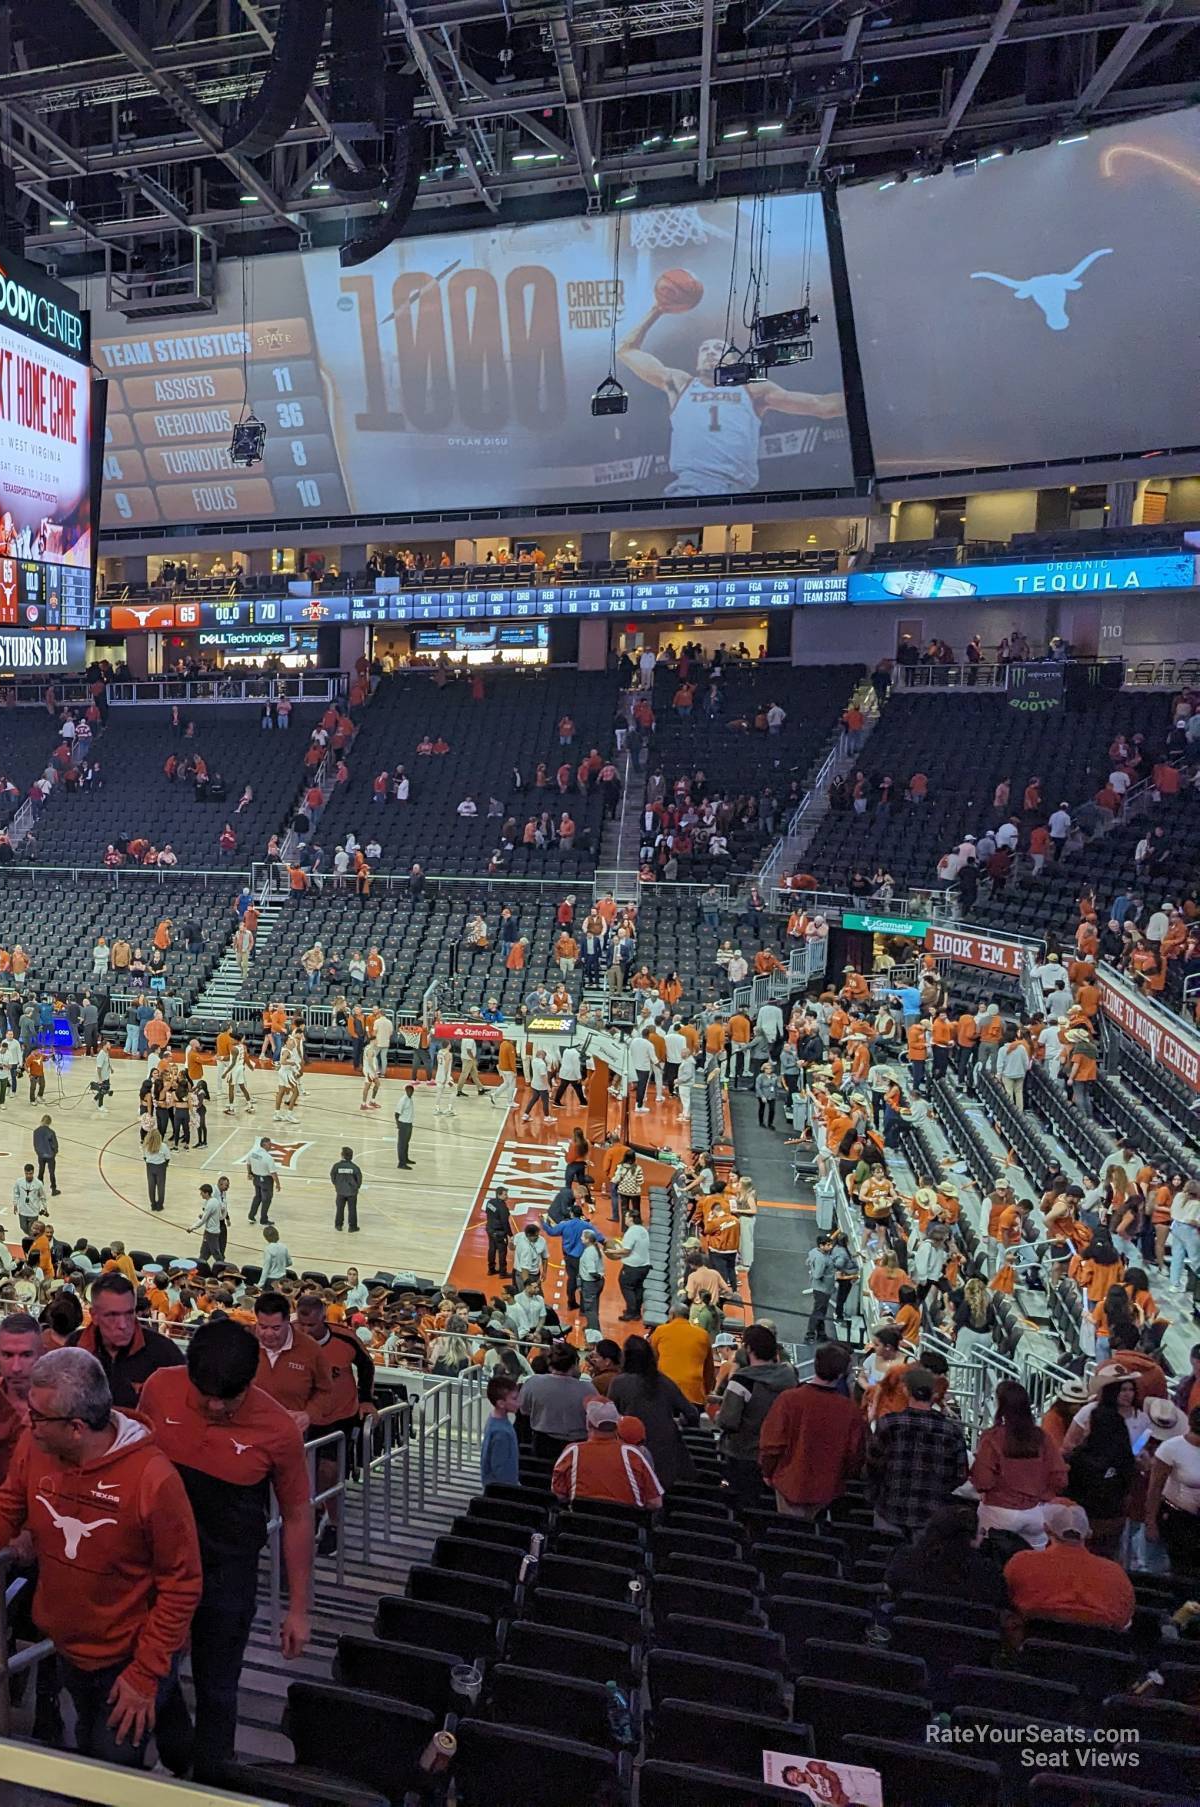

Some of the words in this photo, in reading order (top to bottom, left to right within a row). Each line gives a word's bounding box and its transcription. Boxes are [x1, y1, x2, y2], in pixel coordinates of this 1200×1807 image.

[566, 279, 625, 307] CAREER
[37, 298, 82, 351] CENTER
[567, 308, 613, 329] POINTS
[100, 342, 153, 368] TEAM
[154, 330, 252, 365] STATISTICS
[256, 333, 293, 347] STATE
[339, 265, 568, 432] 1000
[154, 376, 216, 403] ASSISTS
[272, 367, 294, 393] 11
[17, 355, 47, 434] HOME
[49, 370, 77, 444] GAME
[690, 391, 742, 403] TEXAS
[154, 410, 233, 438] REBOUNDS
[276, 402, 305, 429] 36
[709, 405, 721, 432] 1
[8, 436, 28, 453] WEST
[31, 442, 62, 463] VIRGINIA
[448, 438, 481, 446] DYLAN
[484, 438, 508, 446] DISU
[104, 456, 124, 481] 14
[159, 446, 248, 475] TURNOVE
[291, 440, 307, 466] 8
[115, 494, 133, 518] 9
[192, 486, 238, 512] FOULS
[296, 480, 321, 507] 10
[1046, 559, 1109, 572] ORGANIC
[803, 580, 825, 591] IOWA
[826, 578, 848, 590] STATE
[1013, 570, 1142, 593] TEQUILA
[396, 596, 407, 606] STL
[420, 594, 432, 605] BLK
[467, 593, 479, 603] AST
[490, 592, 504, 603] ORB
[516, 591, 530, 601] DRB
[542, 590, 555, 600] REB
[588, 589, 601, 599] FTA
[611, 587, 625, 598] FT%
[637, 587, 652, 597] 3PM
[665, 585, 679, 596] 3PA
[694, 584, 710, 594] 3P%
[725, 583, 736, 593] FG
[748, 581, 762, 592] FGA
[773, 580, 789, 591] FG%
[803, 592, 823, 602] TEAM
[824, 591, 847, 602] STATS
[180, 606, 195, 622] 65
[215, 607, 240, 620] 00.0
[261, 604, 276, 619] 70
[301, 607, 329, 617] STATE
[352, 610, 372, 619] FOULS
[517, 603, 528, 614] 20
[590, 601, 599, 612] 13
[608, 601, 626, 611] 76.9
[667, 599, 676, 609] 17
[691, 597, 710, 608] 35.3
[725, 596, 735, 607] 27
[748, 595, 760, 606] 66
[770, 594, 790, 605] 40.9
[199, 633, 227, 645] DELL
[227, 632, 285, 646] Technologies
[1101, 625, 1122, 638] 110
[43, 635, 67, 666] B-B-Q
[1008, 697, 1060, 712] BOOTH
[1028, 691, 1041, 699] DJ
[876, 920, 914, 931] Germania
[932, 932, 974, 959] HOOK
[1125, 1003, 1135, 1031] TO
[1163, 1034, 1199, 1085] CENTER
[287, 1362, 305, 1371] TEXAS
[90, 1490, 120, 1503] TEXAS
